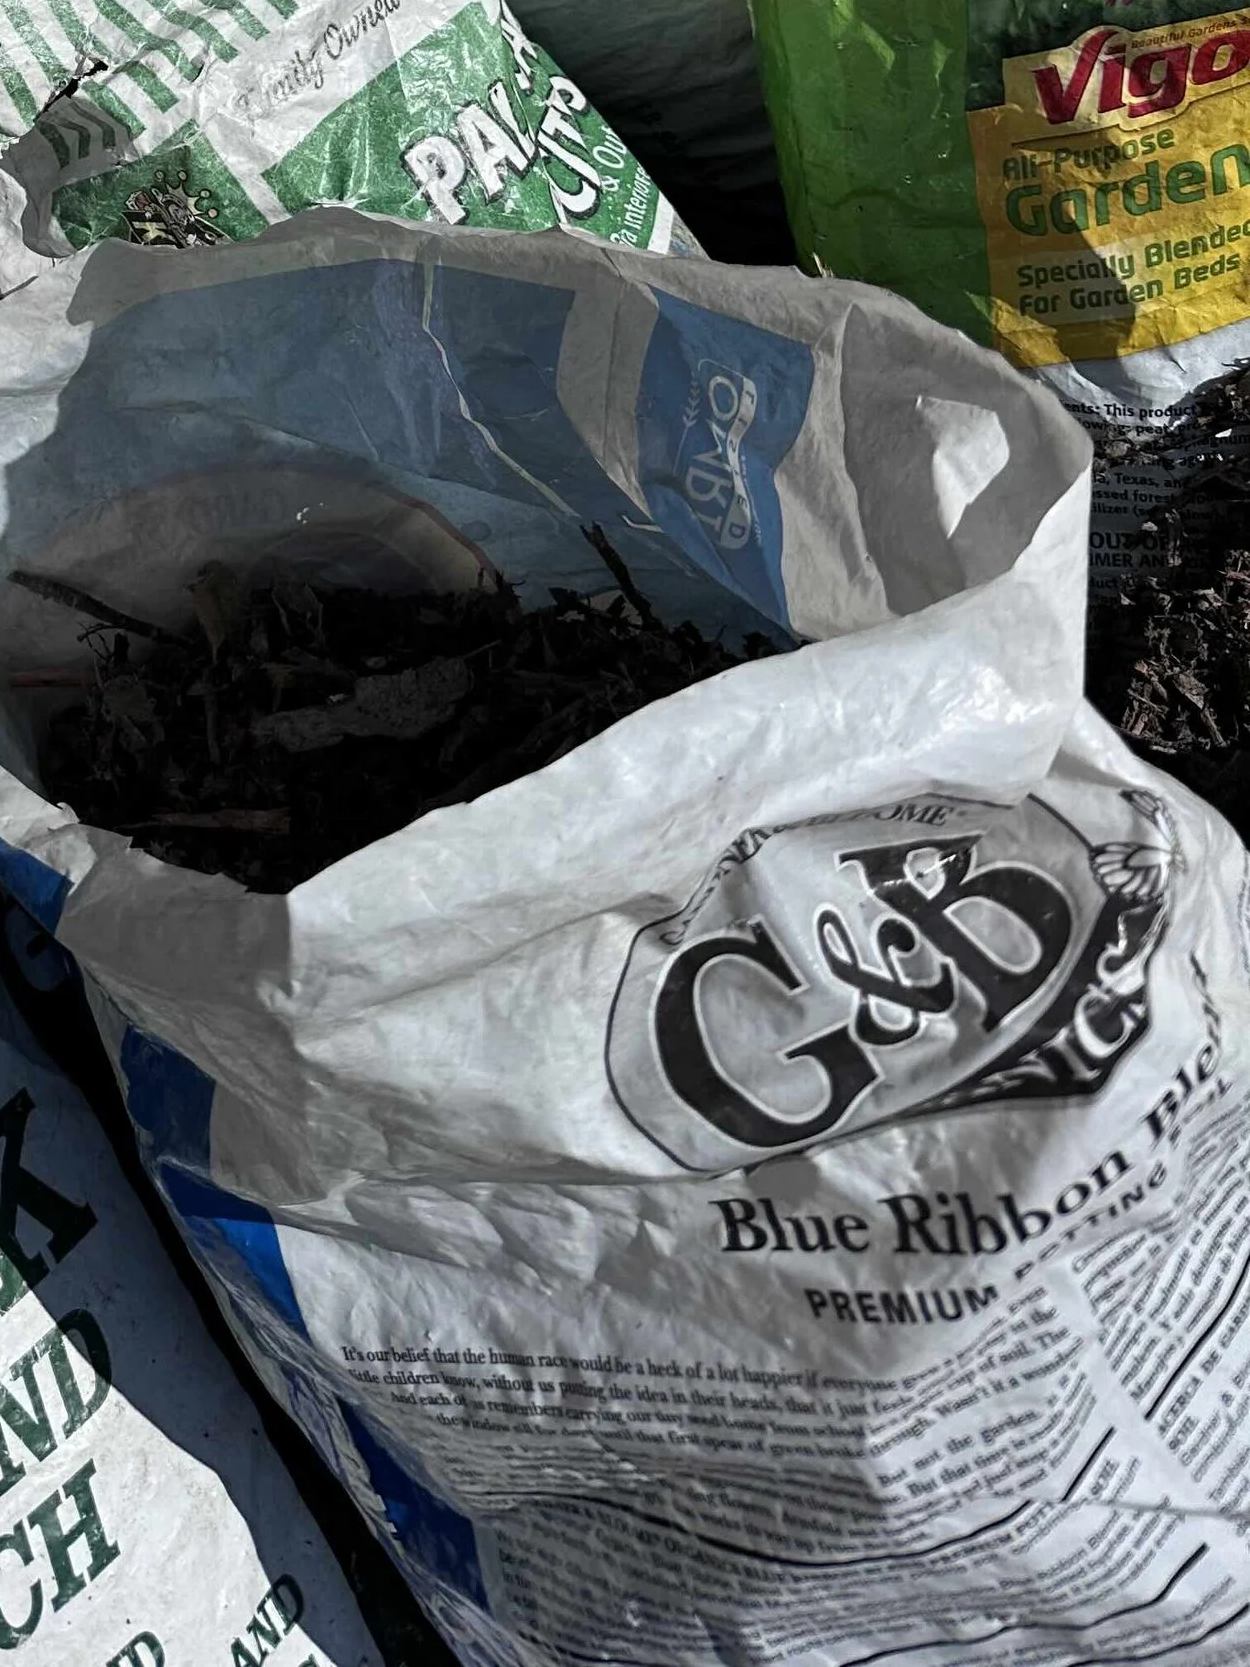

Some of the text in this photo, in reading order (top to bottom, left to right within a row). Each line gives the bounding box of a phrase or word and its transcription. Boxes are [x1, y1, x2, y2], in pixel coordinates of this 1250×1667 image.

[1002, 128, 1176, 181] All-Purpose
[1005, 143, 1250, 237] Garden
[1016, 253, 1135, 292] Specially
[1019, 253, 1240, 317] For Garden Beds
[1103, 403, 1197, 421] This product
[1115, 472, 1159, 489] Texas,
[653, 833, 1074, 1151] G&B
[707, 1196, 870, 1255] Blue
[877, 1149, 1134, 1257] Ribbon
[804, 1283, 1000, 1326] PREMIUM
[342, 1346, 364, 1361] It's
[366, 1350, 391, 1361] our
[391, 1347, 430, 1363] belief
[433, 1348, 460, 1364] that
[462, 1347, 485, 1364] the
[488, 1347, 534, 1367] human
[538, 1355, 568, 1368] race
[568, 1354, 612, 1372] would
[615, 1357, 632, 1374] be
[649, 1359, 682, 1377] heck
[383, 1371, 438, 1385] children
[483, 1375, 535, 1392] without
[538, 1379, 554, 1392] us
[609, 1384, 631, 1401] the
[637, 1385, 668, 1403] idea
[692, 1390, 726, 1408] their
